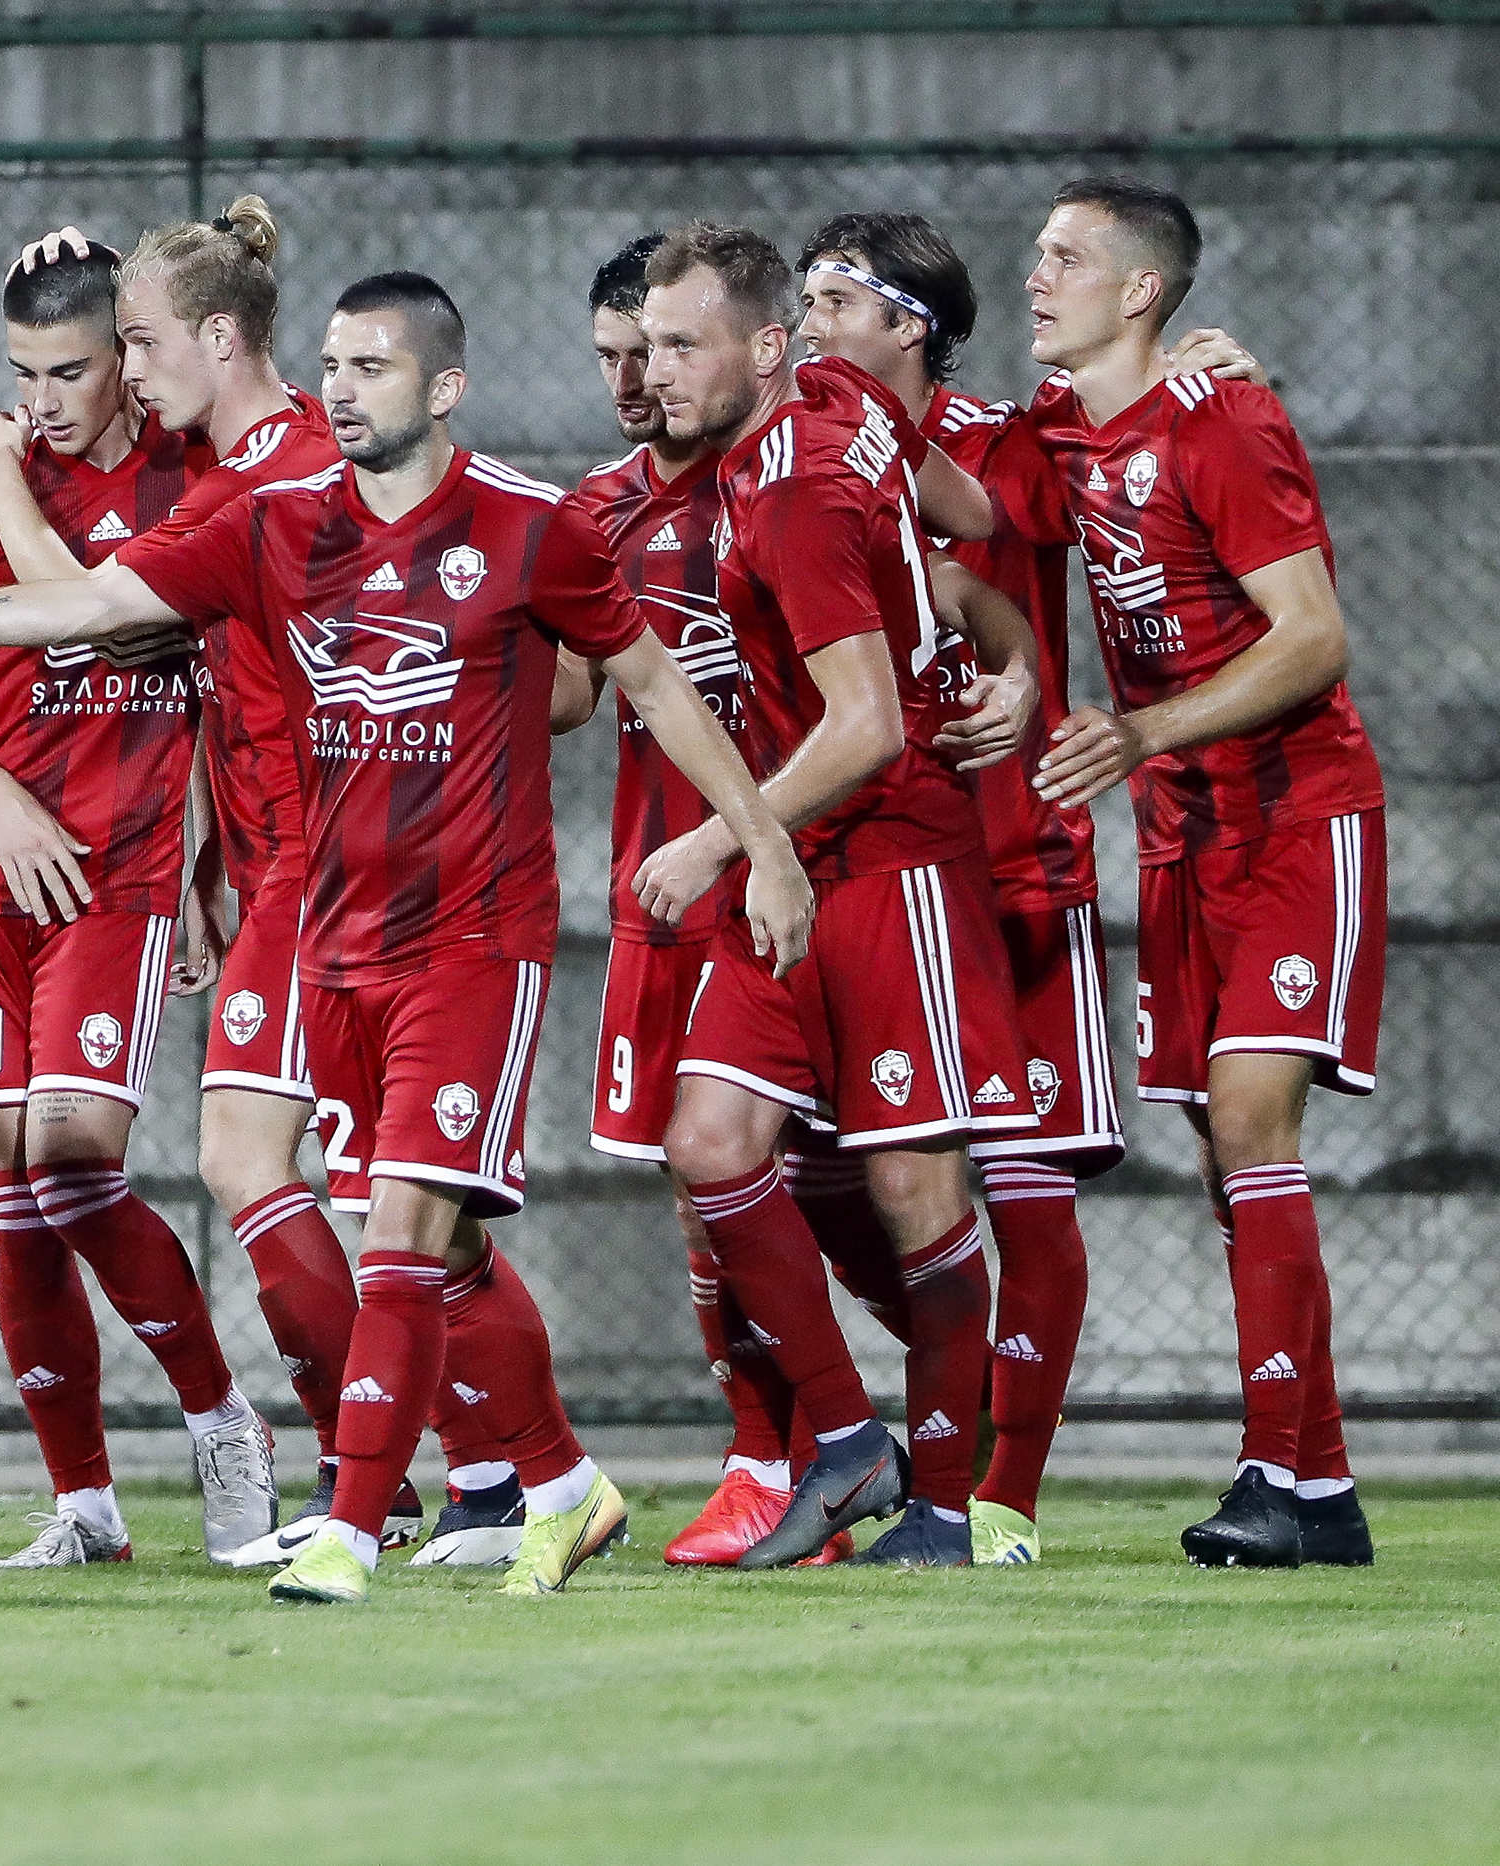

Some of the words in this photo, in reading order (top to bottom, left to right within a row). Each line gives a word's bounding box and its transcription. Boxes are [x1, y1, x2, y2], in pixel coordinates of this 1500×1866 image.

[88, 528, 133, 542] adidas
[646, 541, 682, 552] adidas
[361, 580, 404, 591] adidas
[31, 674, 189, 705] STADION
[121, 700, 187, 714] CENTER
[306, 717, 454, 746] STADION
[378, 748, 452, 762] CENTER
[607, 1034, 634, 1114] 9
[973, 1091, 1016, 1104] adidas
[315, 1097, 362, 1173] 2
[1249, 1369, 1298, 1381] adidas
